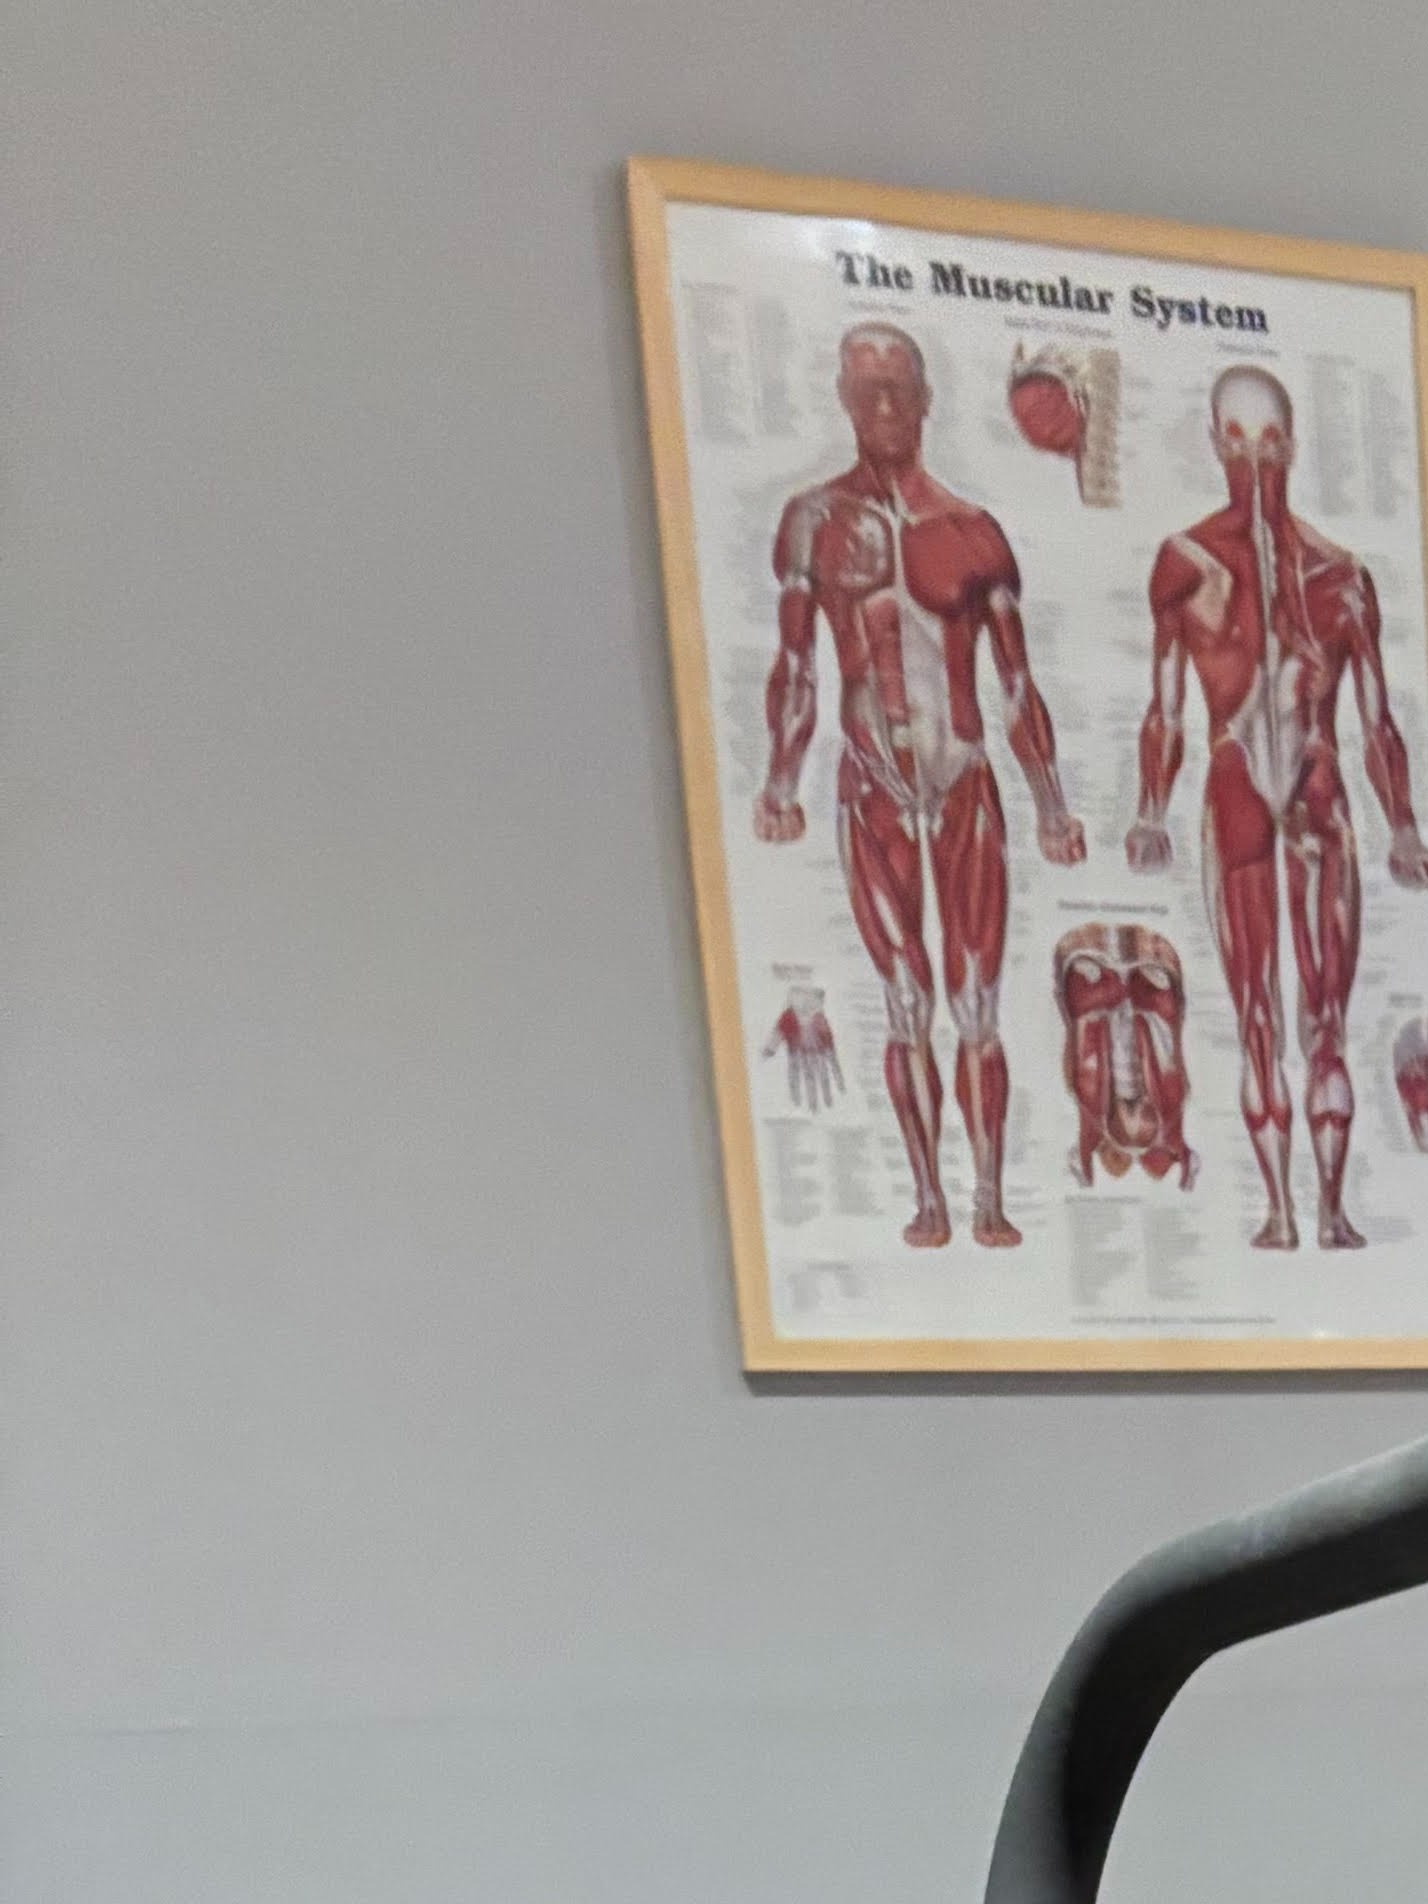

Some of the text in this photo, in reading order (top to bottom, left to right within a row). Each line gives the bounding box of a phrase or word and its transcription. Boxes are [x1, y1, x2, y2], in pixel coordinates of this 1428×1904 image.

[836, 249, 914, 290] The
[928, 261, 1114, 315] Muscular
[1130, 285, 1270, 334] System
